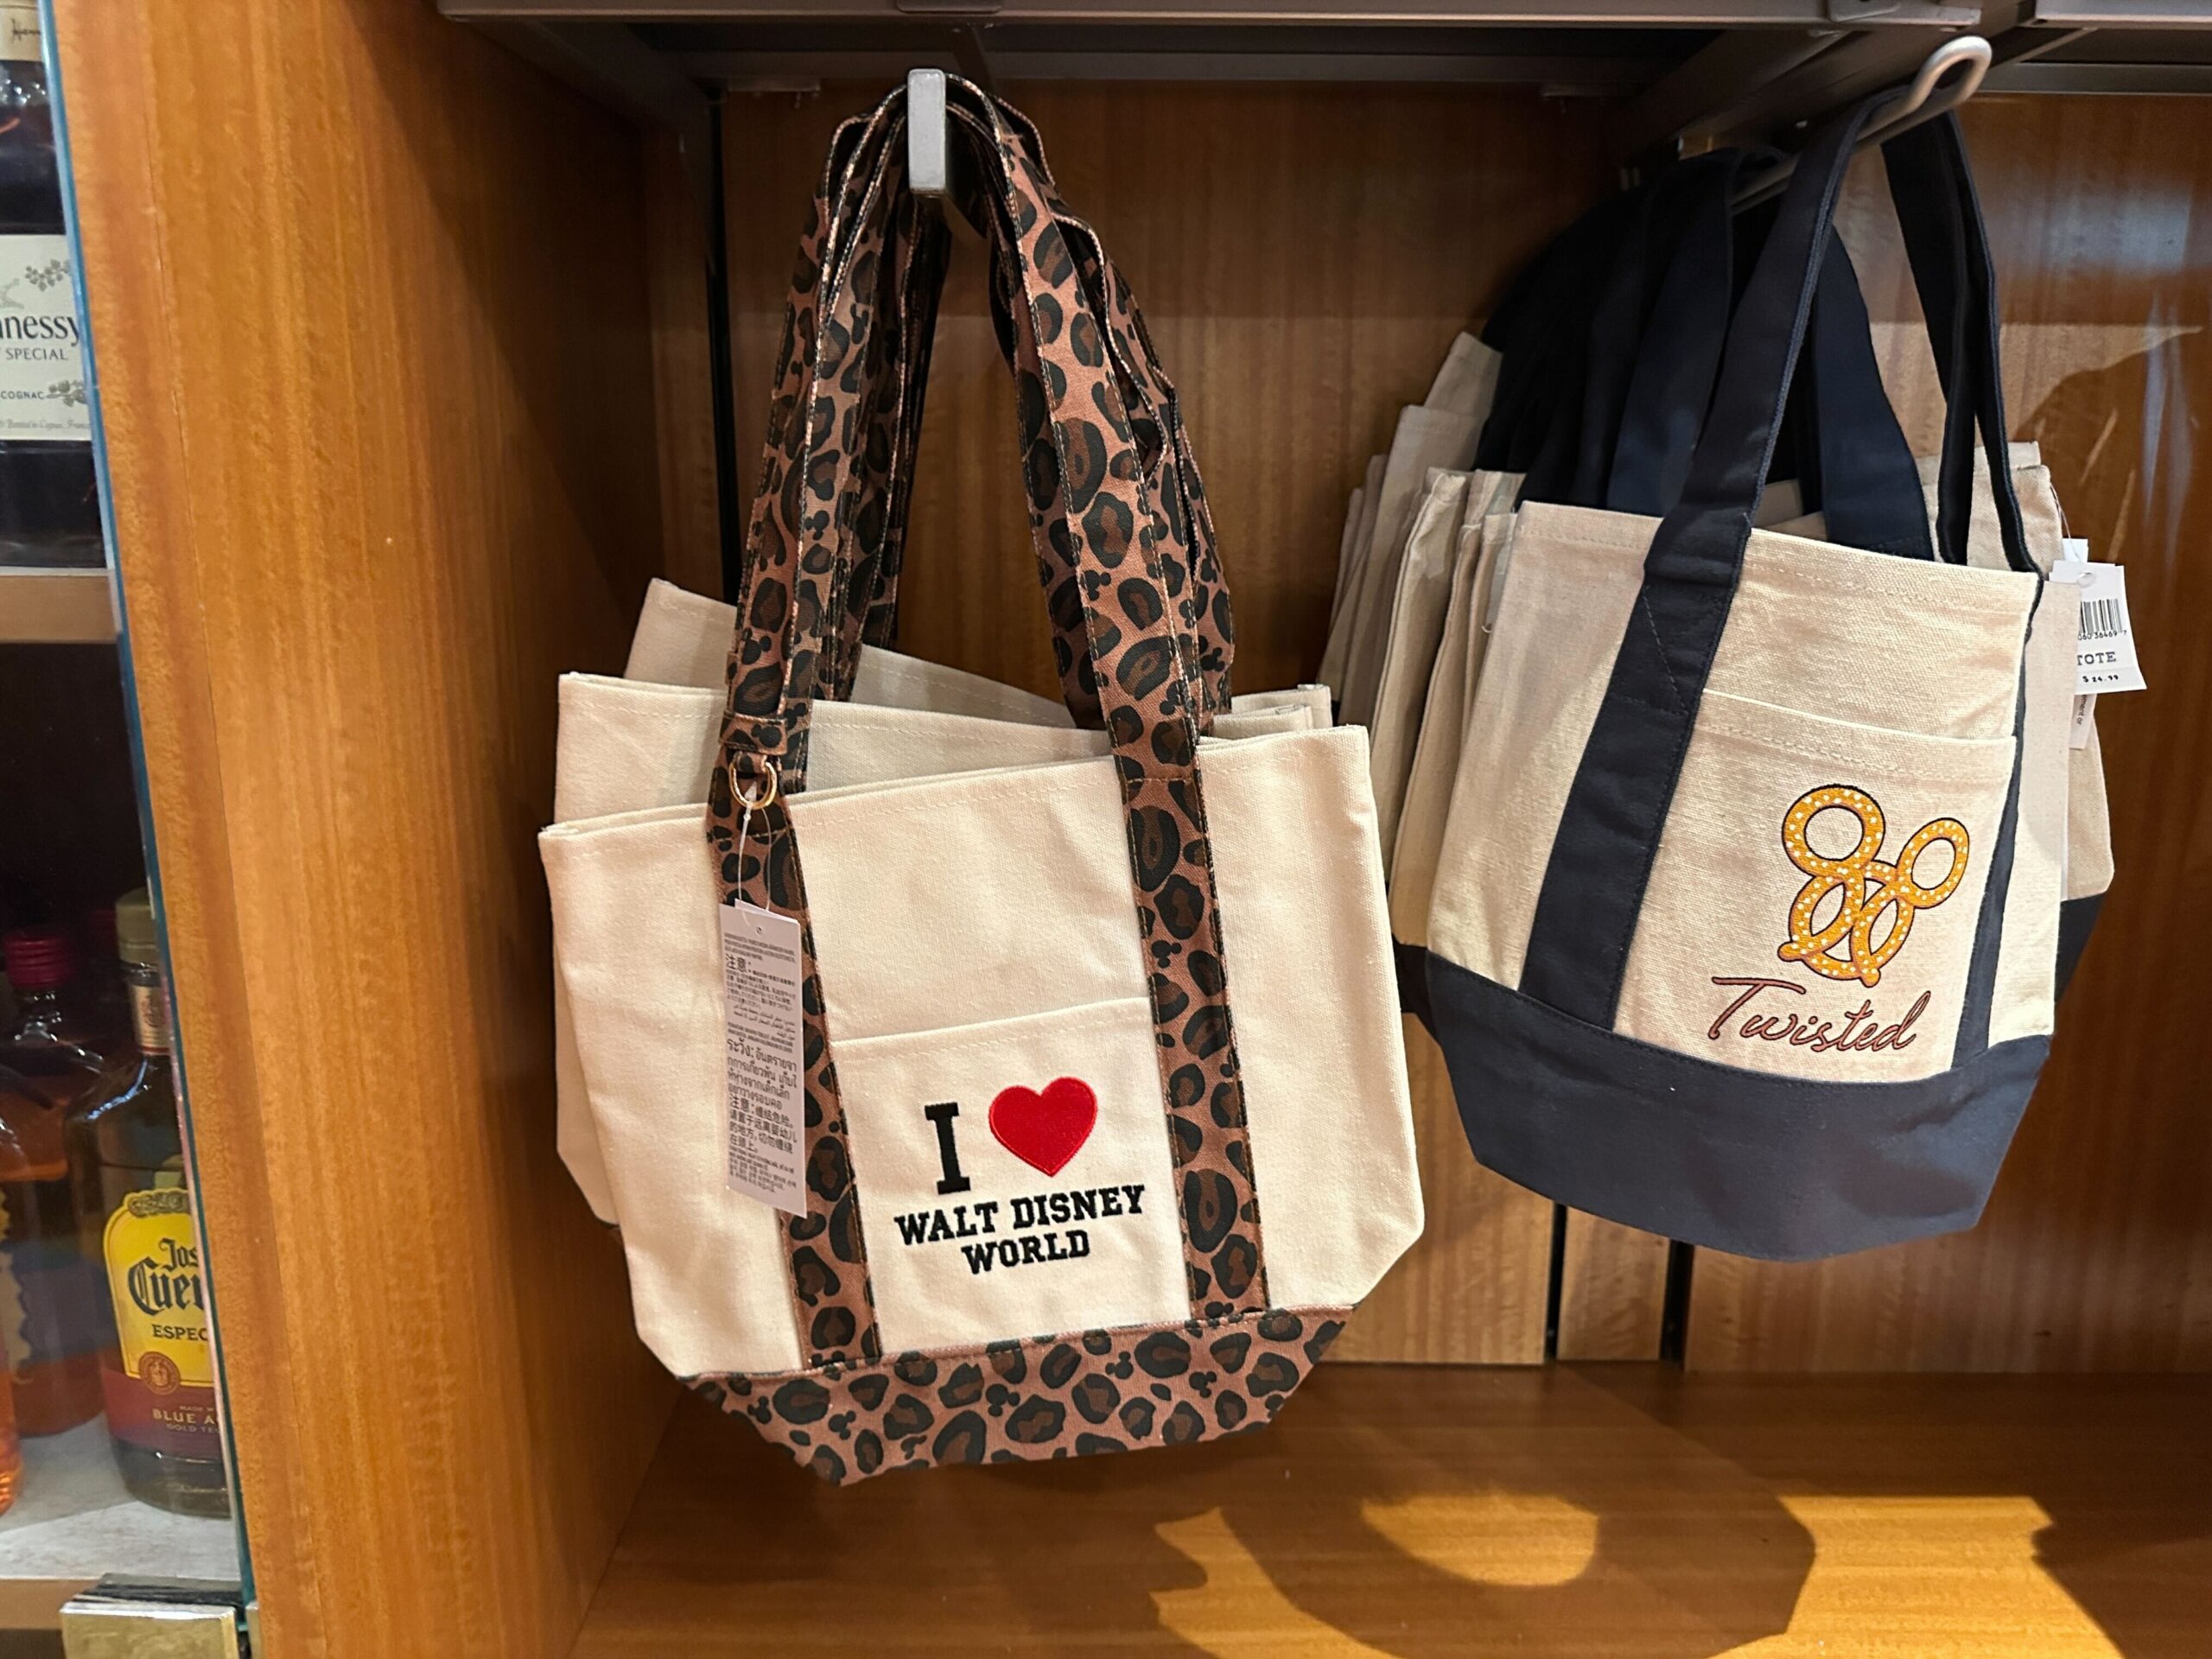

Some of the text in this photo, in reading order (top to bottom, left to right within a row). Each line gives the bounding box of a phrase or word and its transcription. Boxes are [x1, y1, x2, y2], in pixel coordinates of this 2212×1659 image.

[0, 315, 79, 347] nessy
[6, 347, 68, 361] SPECIAL
[1, 390, 44, 400] COGNAC
[2076, 652, 2117, 666] TOTE
[1707, 976, 1932, 1052] Twisted
[924, 1102, 971, 1195] I
[893, 1185, 1146, 1246] WALT DISNEY
[961, 1230, 1090, 1275] WORLD
[152, 1408, 197, 1424] BLUE
